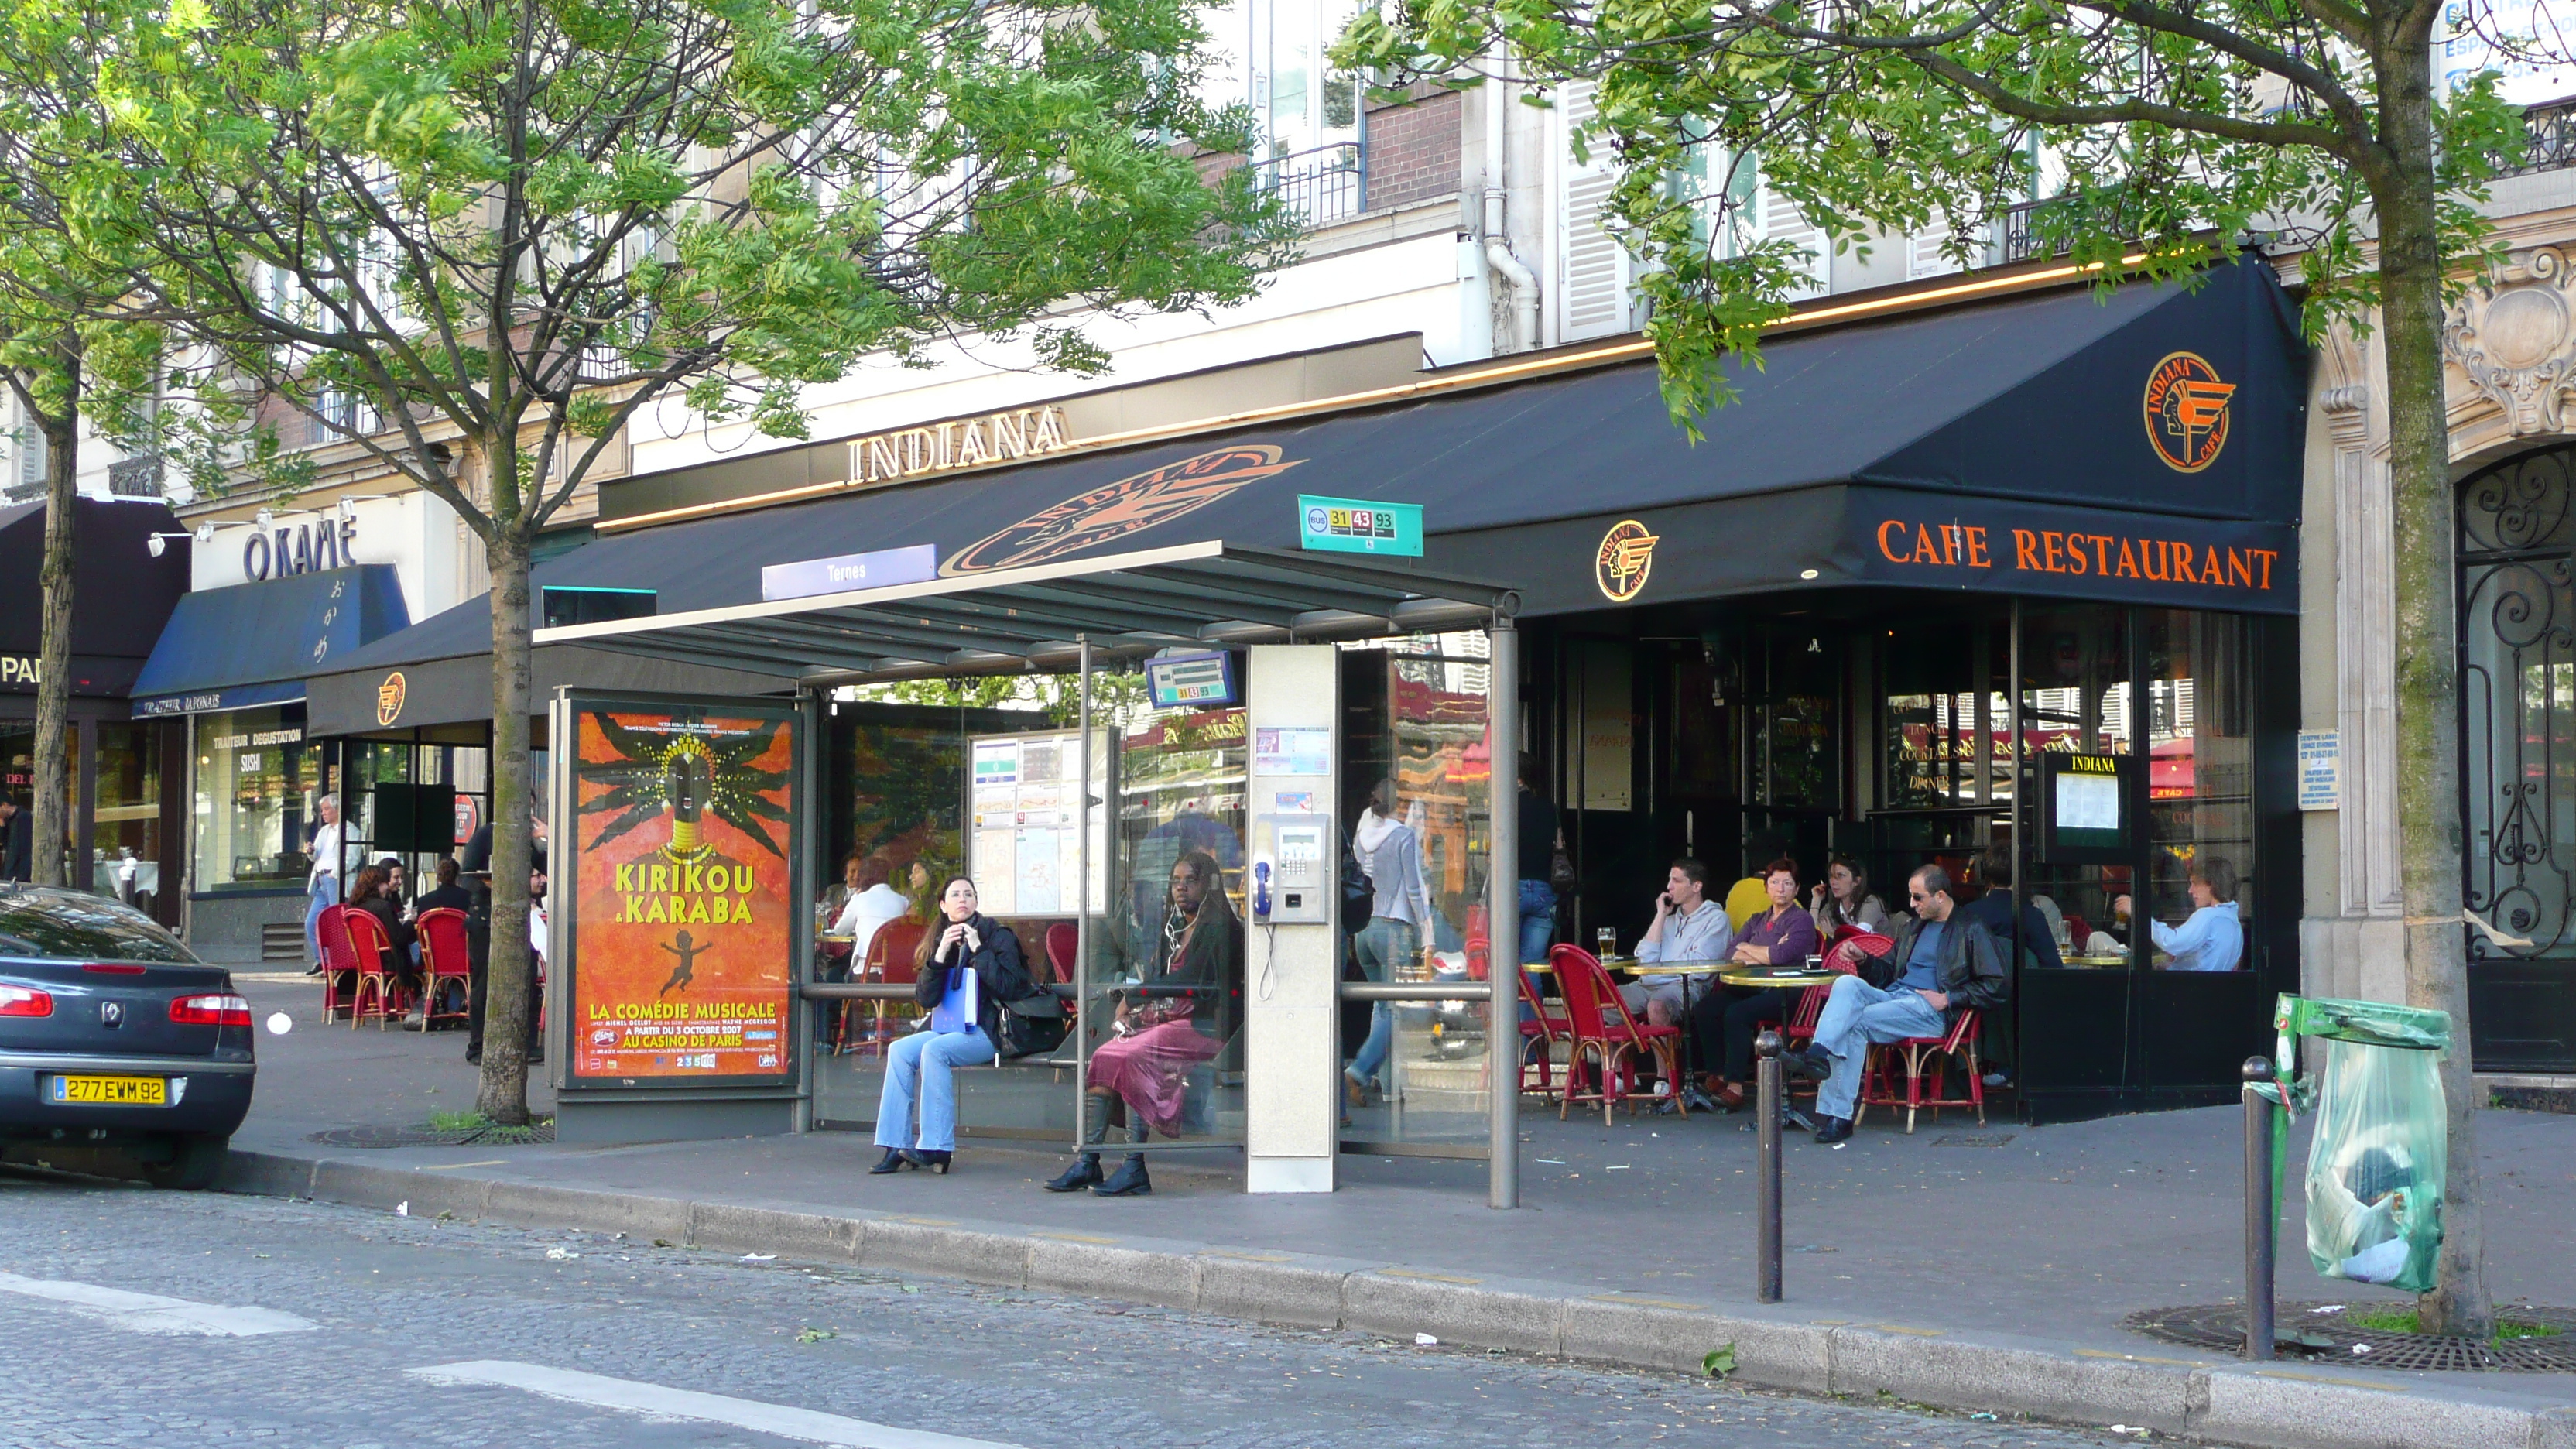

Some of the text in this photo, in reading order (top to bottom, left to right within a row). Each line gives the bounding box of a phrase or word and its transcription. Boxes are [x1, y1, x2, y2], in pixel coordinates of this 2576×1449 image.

[2148, 358, 2191, 414] INDIANA
[846, 405, 1069, 485] INDIANA
[2200, 430, 2221, 461] CAFE
[1015, 453, 1233, 529] INDIANA
[1310, 516, 1326, 525] BUS
[1331, 510, 1392, 528] 31 43 93
[243, 515, 357, 581] OKAME
[1876, 519, 2278, 591] CAFE RESTAURANT
[827, 563, 866, 582] Ternes
[1178, 687, 1209, 699] 31 43 93
[214, 728, 302, 750] TRAITEUR DEGUSTATION
[241, 753, 261, 772] SUSHI
[2071, 755, 2115, 772] INDIANA
[1910, 775, 1950, 790] DINNER
[615, 863, 754, 894] KIRIKOU
[615, 894, 754, 925] & KARABA
[590, 999, 776, 1019] LA COMÉDIE MUSICALE
[625, 1026, 632, 1035] A
[662, 1026, 674, 1035] DU
[676, 1026, 681, 1035] 3
[683, 1026, 720, 1035] OCTOBRE
[721, 1025, 742, 1034] 2007
[622, 1034, 742, 1048] AU CASINO DE PARIS
[68, 1080, 101, 1098] 277
[104, 1081, 137, 1101] EWM
[141, 1082, 161, 1101] 92
